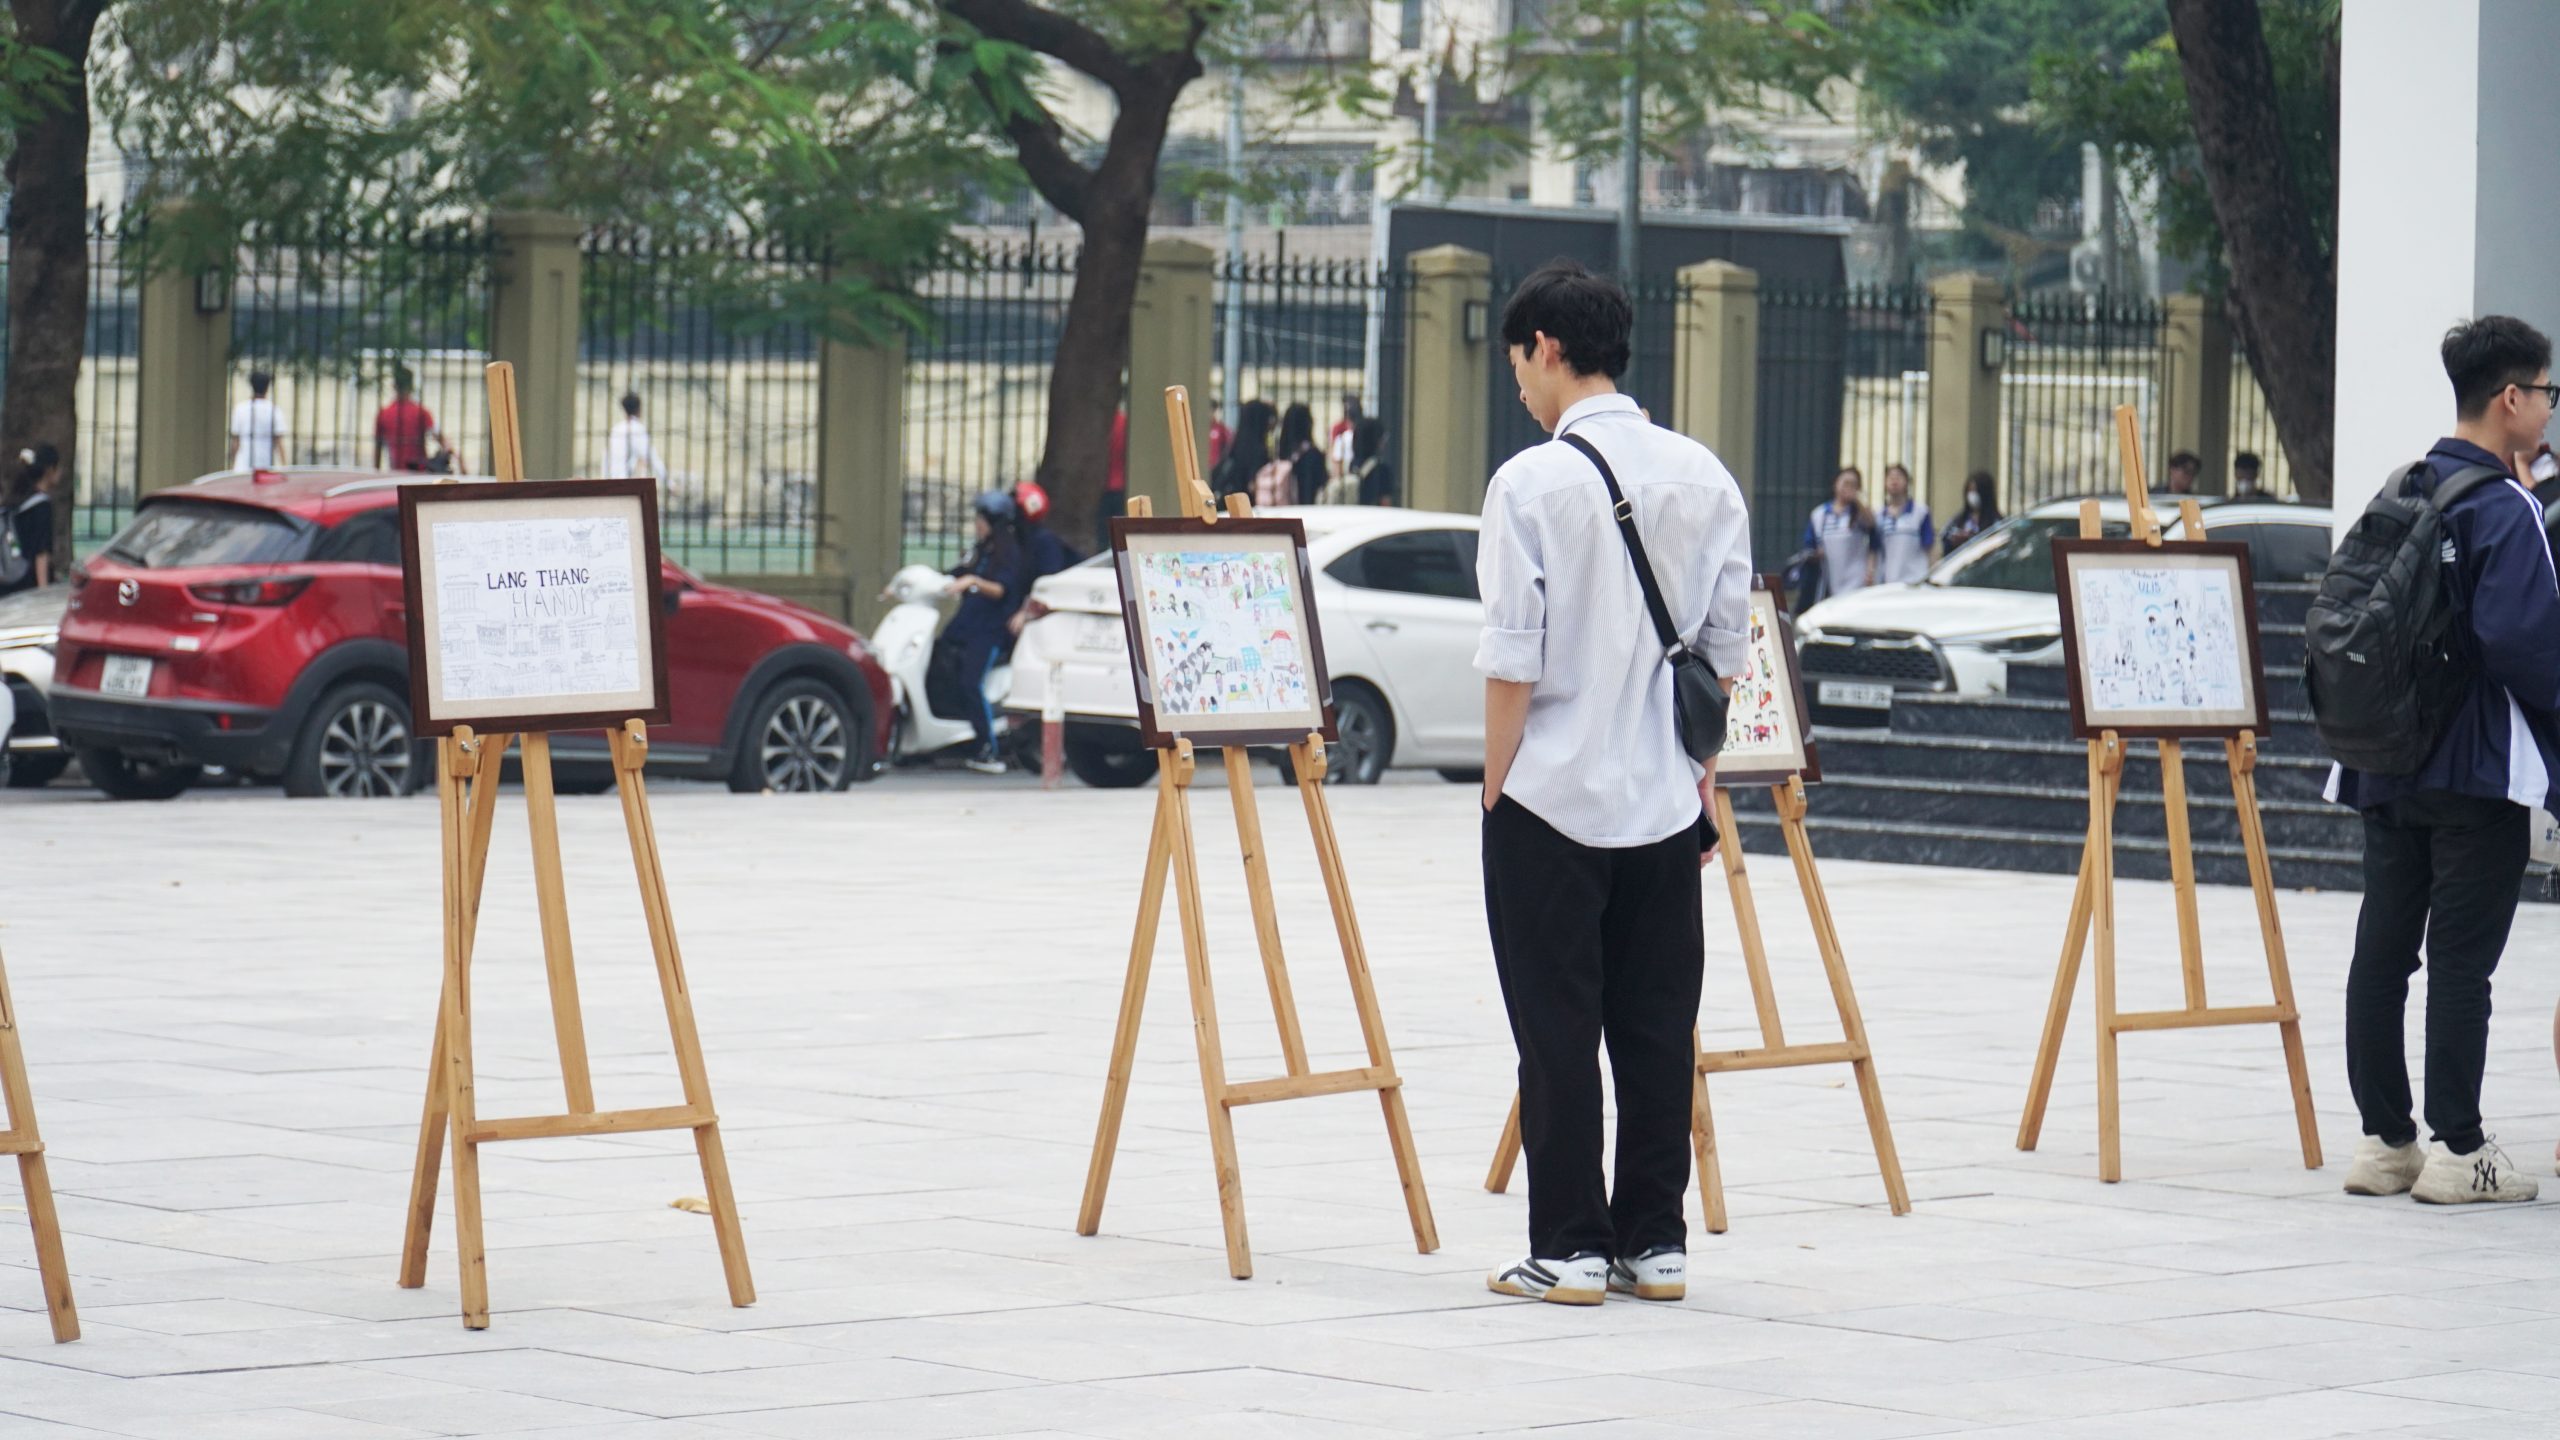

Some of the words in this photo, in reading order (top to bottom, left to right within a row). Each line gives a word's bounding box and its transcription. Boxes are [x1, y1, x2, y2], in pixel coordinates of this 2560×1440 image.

[486, 571, 528, 590] LANG
[535, 567, 591, 588] THANG
[512, 586, 587, 619] HANOI
[2471, 1156, 2499, 1193] NY
